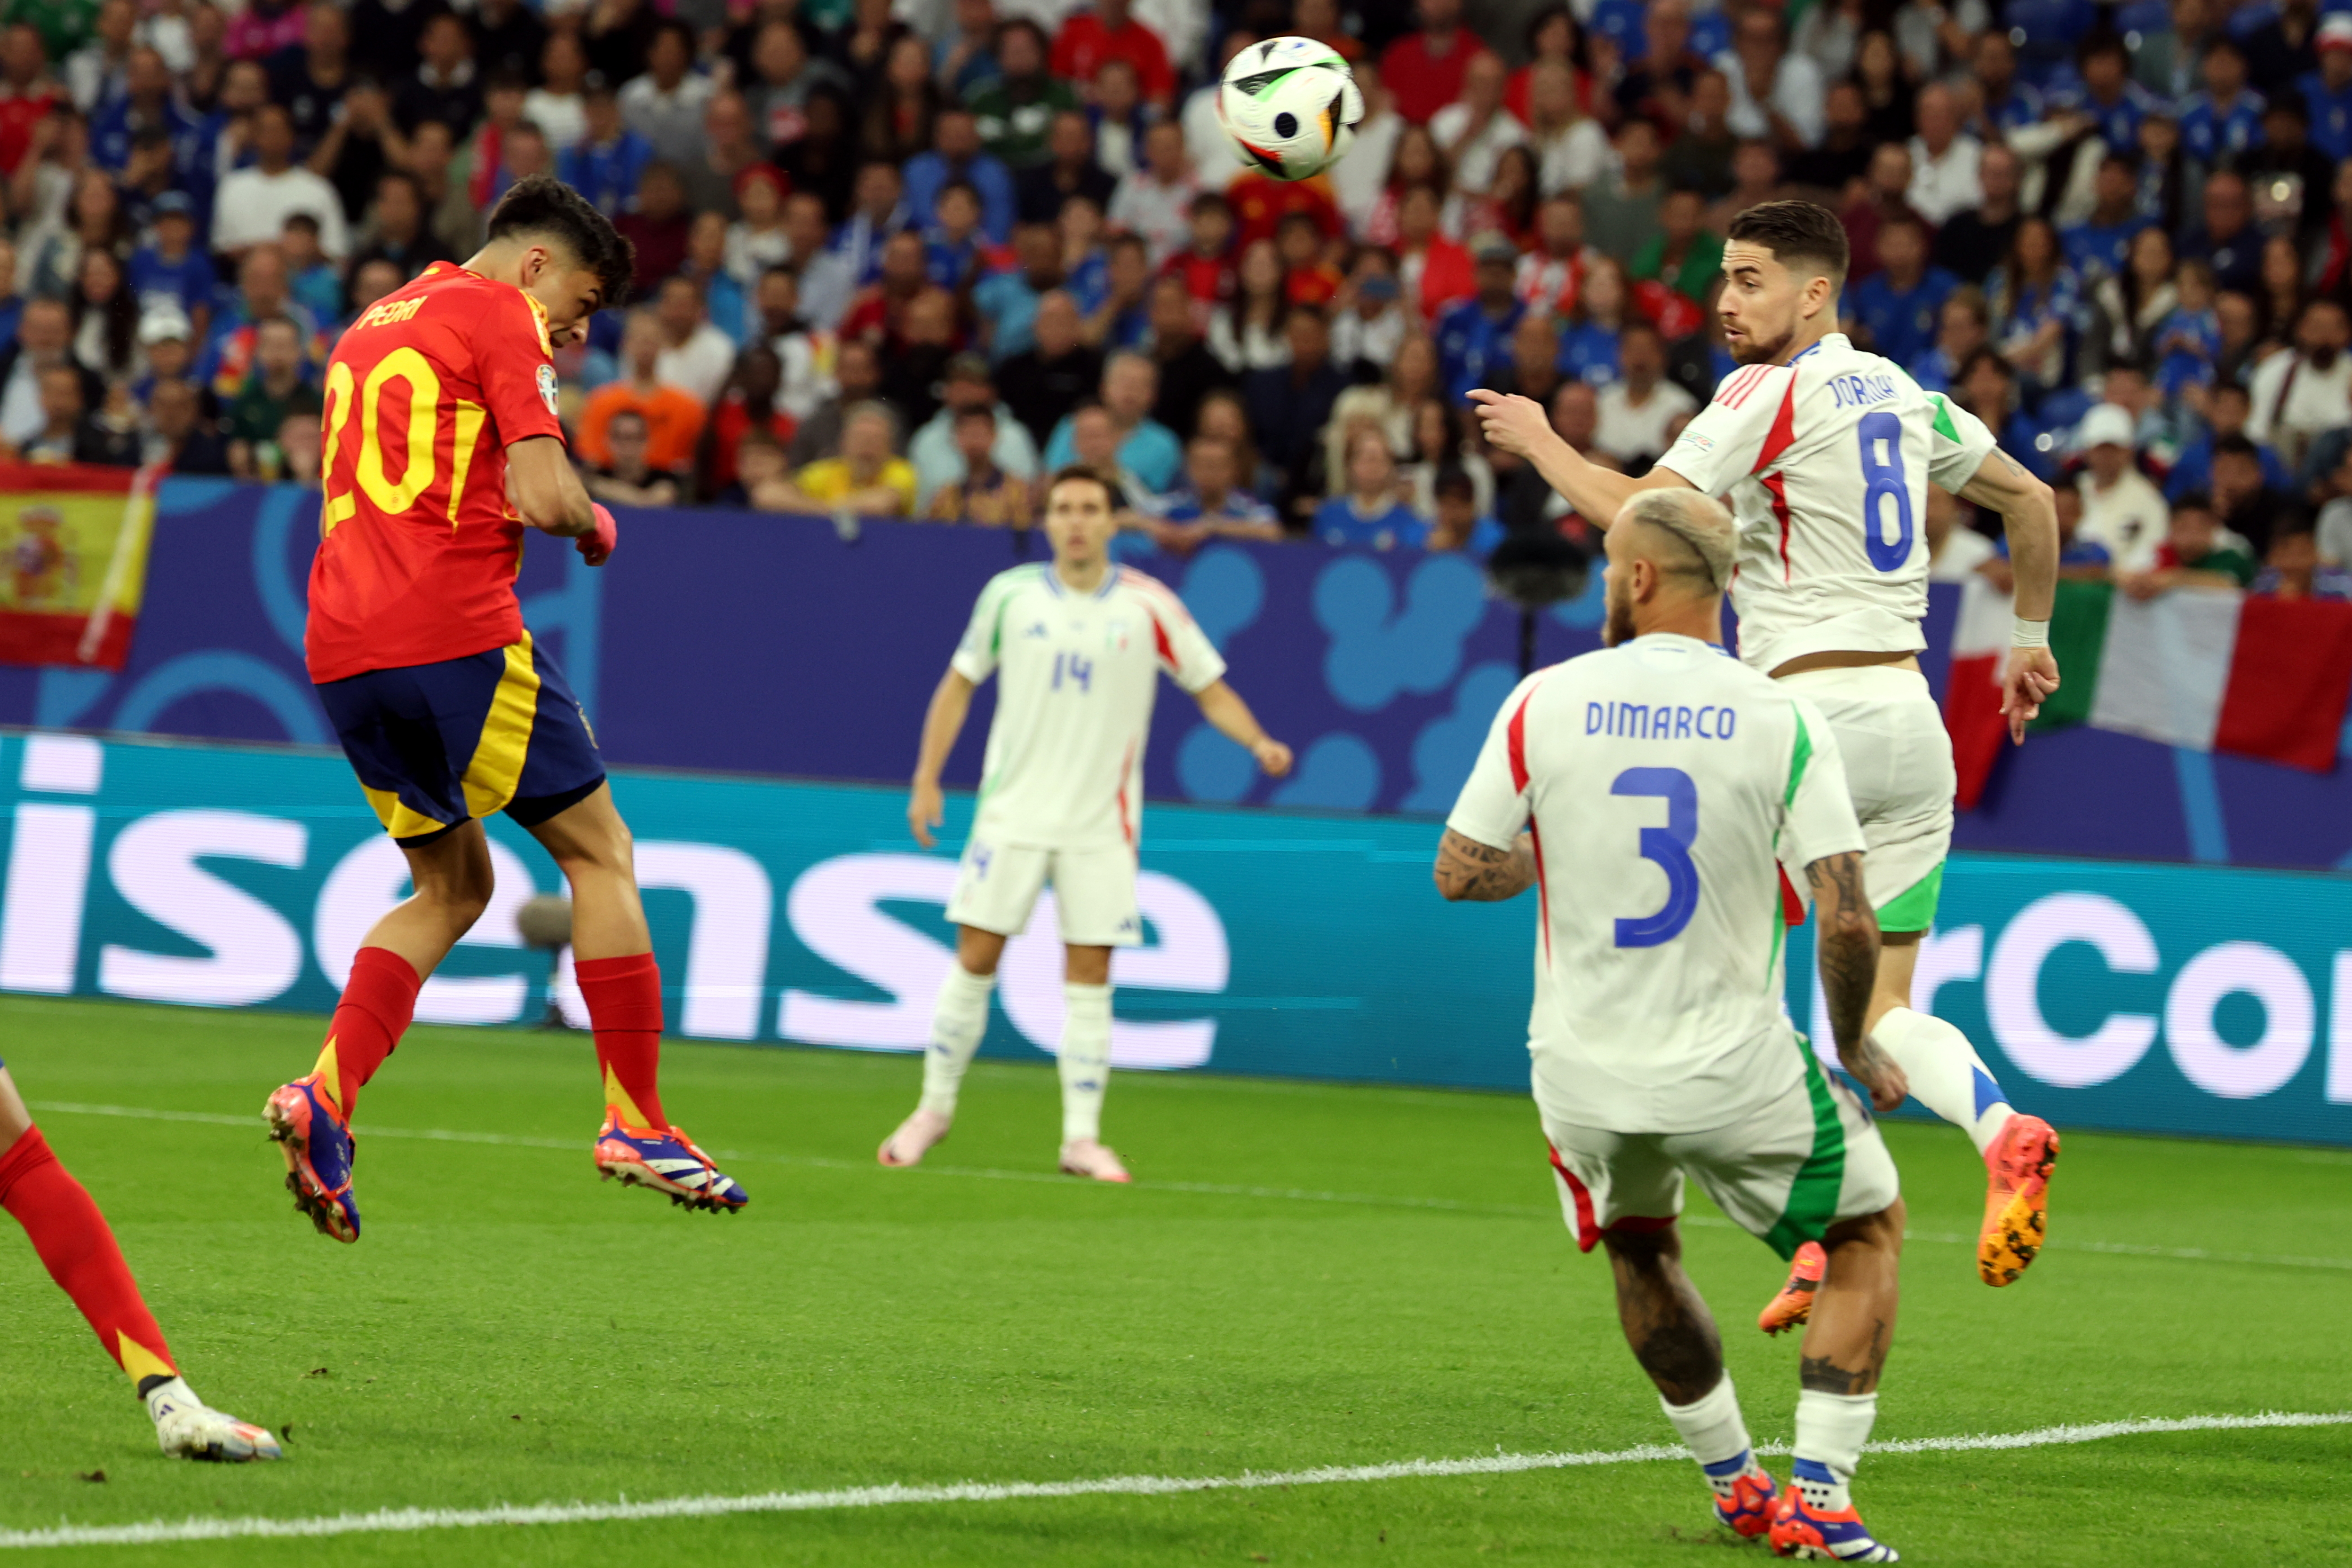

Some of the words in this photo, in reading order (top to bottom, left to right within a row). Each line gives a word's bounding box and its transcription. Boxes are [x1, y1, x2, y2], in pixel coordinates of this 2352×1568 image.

[356, 296, 428, 330] PEDRI
[321, 347, 440, 537] 20
[1858, 412, 1913, 572] 8
[1051, 651, 1092, 694] 14
[1585, 701, 1736, 740] DIMARCO
[1610, 767, 1699, 948] 3
